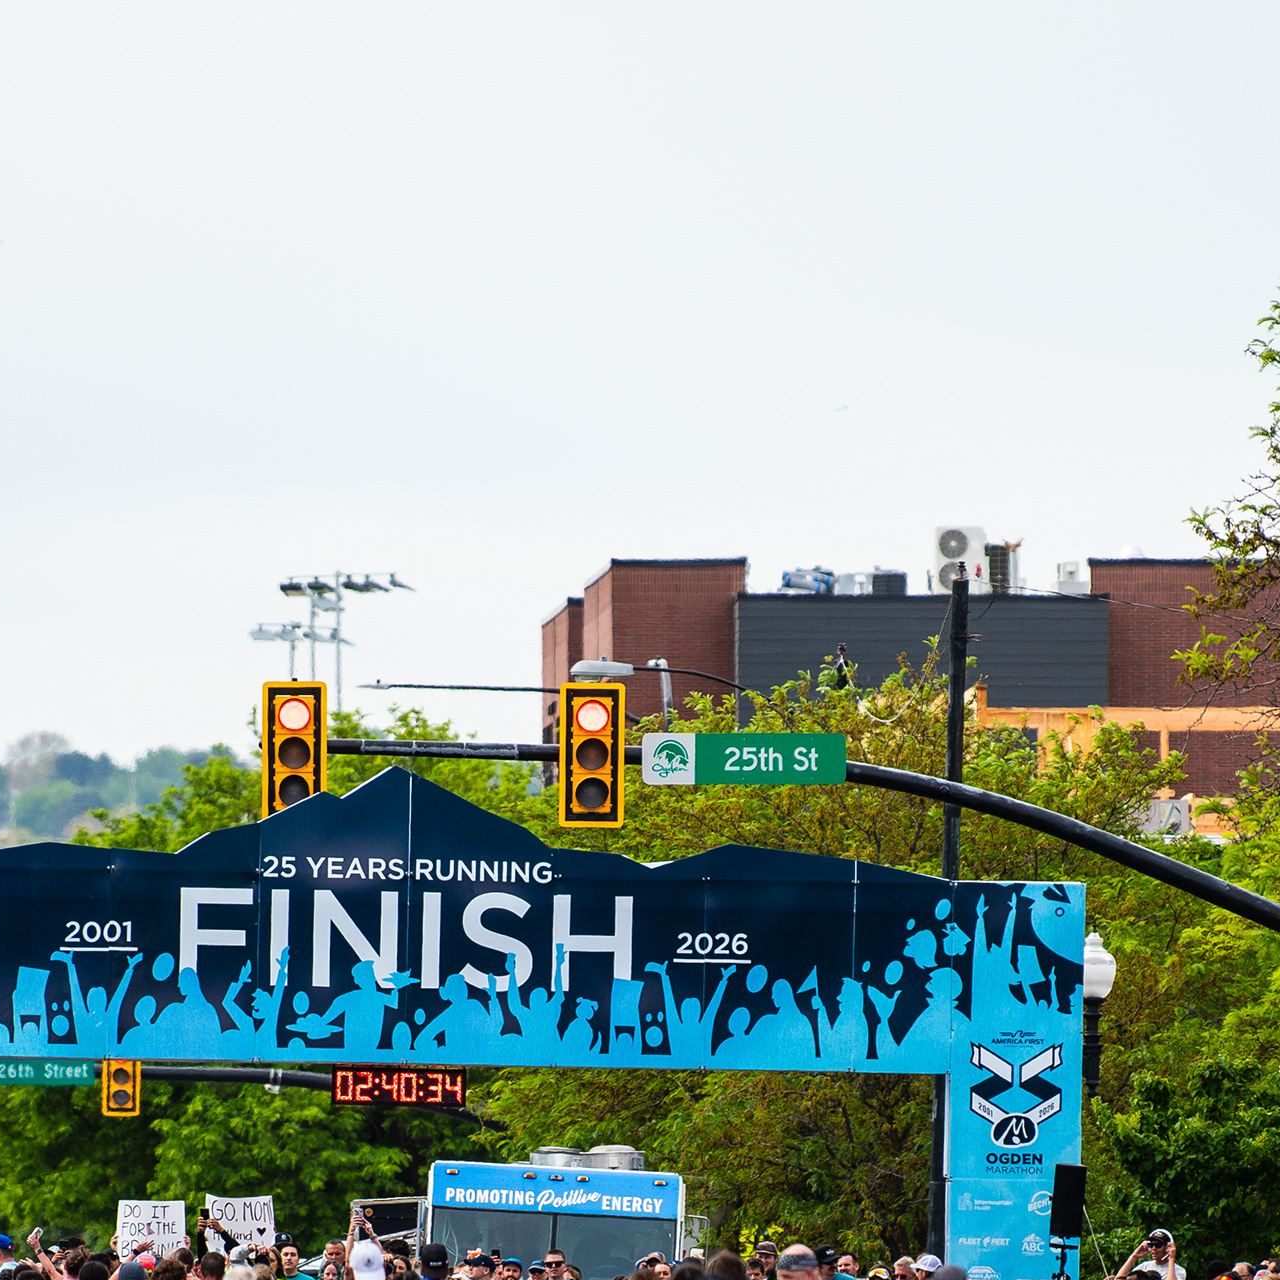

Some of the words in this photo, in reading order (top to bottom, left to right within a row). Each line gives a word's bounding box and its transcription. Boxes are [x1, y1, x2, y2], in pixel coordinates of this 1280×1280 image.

[724, 746, 783, 772] 25th
[793, 747, 818, 772] St
[652, 763, 689, 778] Ogden
[262, 856, 296, 878] 25
[306, 857, 405, 881] YEARS
[415, 859, 553, 884] RUNNING
[64, 920, 133, 943] 2001
[179, 886, 634, 993] FINISH
[676, 932, 749, 956] 2026
[44, 1064, 88, 1079] Street
[336, 1071, 462, 1104] 02:40:34
[986, 1152, 1043, 1165] OGDEN
[986, 1166, 1043, 1174] MARATHON
[445, 1187, 535, 1206] PROMOTING
[536, 1188, 601, 1211] Positive
[602, 1196, 663, 1214] ENERGY
[124, 1204, 142, 1218] DO
[152, 1205, 170, 1220] IT
[211, 1200, 238, 1222] GO,
[243, 1201, 274, 1224] MOM!
[122, 1221, 146, 1237] FOR
[156, 1220, 178, 1236] THE
[990, 1238, 1010, 1246] FEET
[1022, 1242, 1045, 1252] ABC
